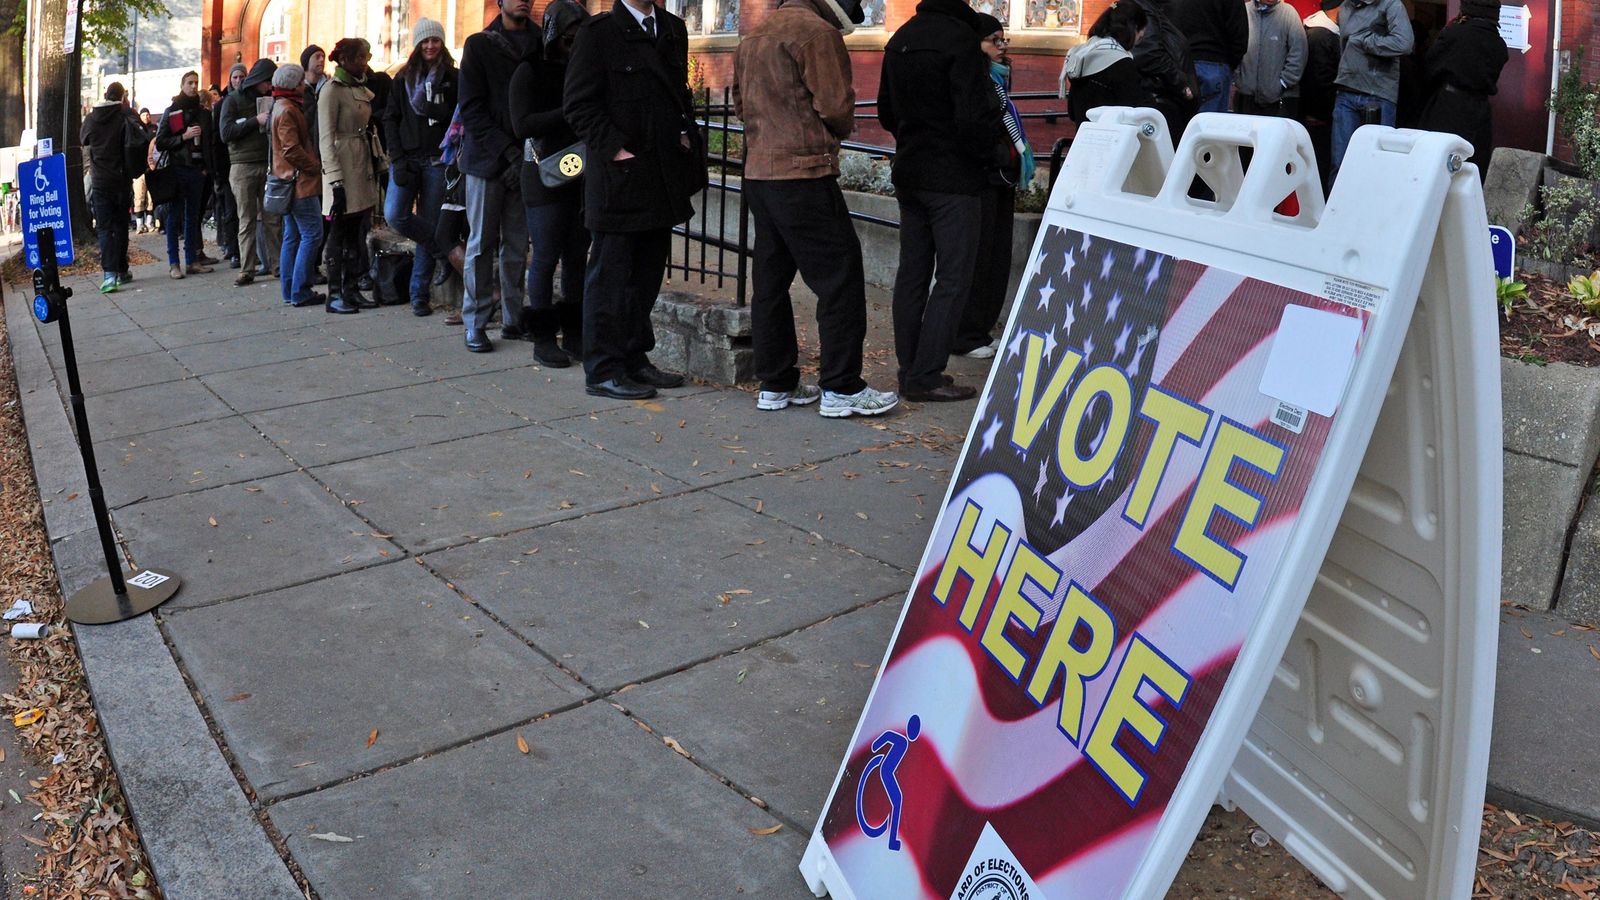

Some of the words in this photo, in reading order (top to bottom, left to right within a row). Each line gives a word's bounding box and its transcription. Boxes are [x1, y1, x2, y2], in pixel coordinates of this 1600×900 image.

[29, 208, 39, 219] for
[39, 205, 62, 218] Voting
[30, 194, 44, 206] Ring
[45, 190, 58, 202] Bell
[1009, 328, 1289, 593] VOTE
[931, 497, 1194, 808] HERE
[957, 874, 973, 900] ARD
[974, 861, 986, 877] OF
[988, 858, 1030, 900] ELECTIONS
[975, 882, 1000, 896] DISTRICT
